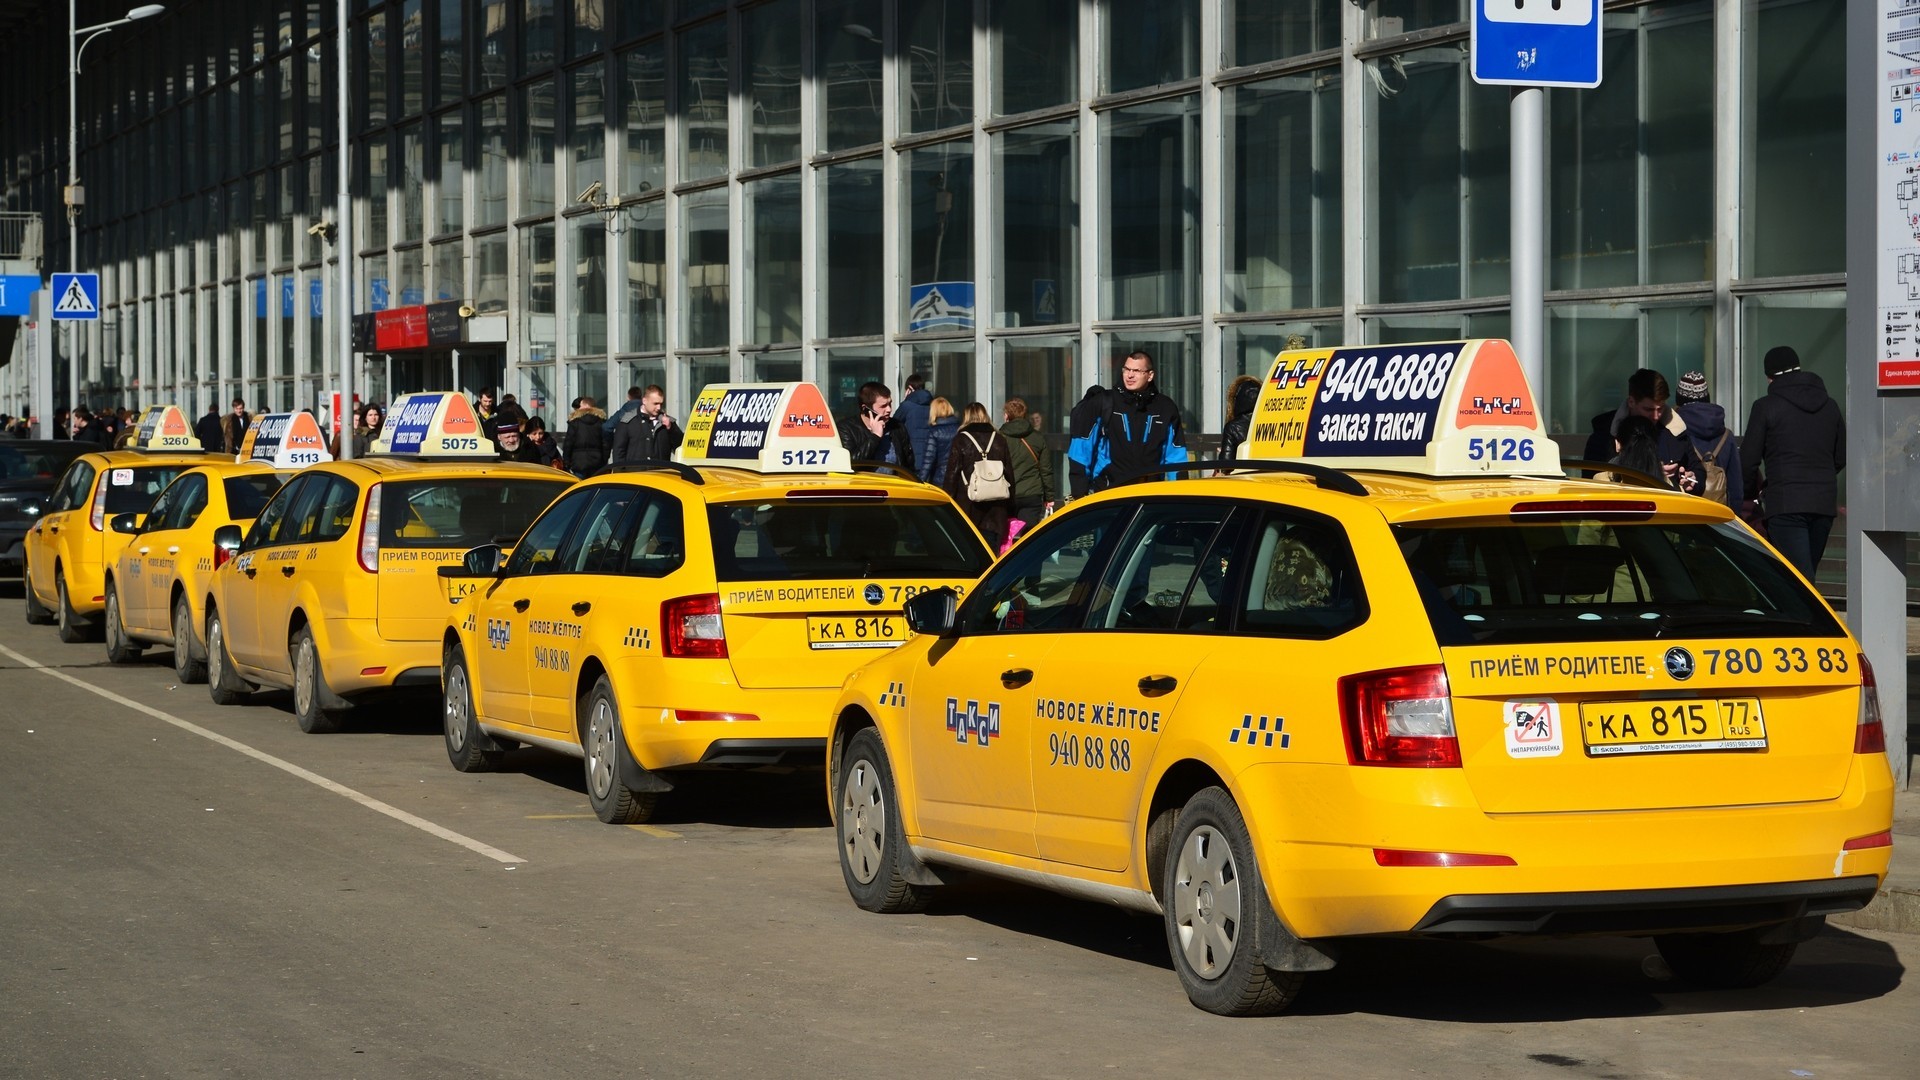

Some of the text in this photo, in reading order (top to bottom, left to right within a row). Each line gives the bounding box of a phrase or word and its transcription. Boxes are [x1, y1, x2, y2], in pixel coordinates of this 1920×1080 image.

[1271, 358, 1327, 389] ТАКСИ
[1320, 352, 1454, 403] 940-8888
[717, 393, 780, 423] 940-8888
[1264, 394, 1307, 411] НОВОЕ ЖЁЛТОЕ
[1474, 397, 1520, 414] ТАКСИ
[789, 414, 823, 426] ТАКСИ
[1318, 412, 1427, 442] заказ такси
[162, 437, 189, 445] 3260
[292, 436, 316, 444] ТАКСИ
[739, 430, 764, 447] такси
[1255, 417, 1304, 448] www.nyt.ru
[442, 438, 478, 450] 5075
[1468, 438, 1534, 461] 5126
[291, 453, 319, 463] 5113
[782, 450, 830, 465] 5127
[382, 550, 461, 561] ПРИЁМ ВОДИТЕ
[729, 585, 855, 604] ПРИЁМ ВОДИТЕЛЕЙ
[529, 620, 582, 638] НОВОЕ ЖЁЛТОЕ
[855, 618, 893, 638] 816
[535, 646, 570, 672] 940 88 88
[1470, 657, 1540, 679] ПРИЁМ
[1703, 647, 1849, 676] 780 33 83
[947, 698, 1000, 746] ТАКСИ
[1037, 698, 1160, 732] НОВОЕ ЖЁЛТОЕ
[1651, 705, 1707, 736] 815
[1722, 702, 1749, 725] 77
[1730, 727, 1750, 735] RUS
[1050, 731, 1131, 772] 940 88 88
[1511, 745, 1560, 753] #НЕПАРКУЙРЕБЁНКА
